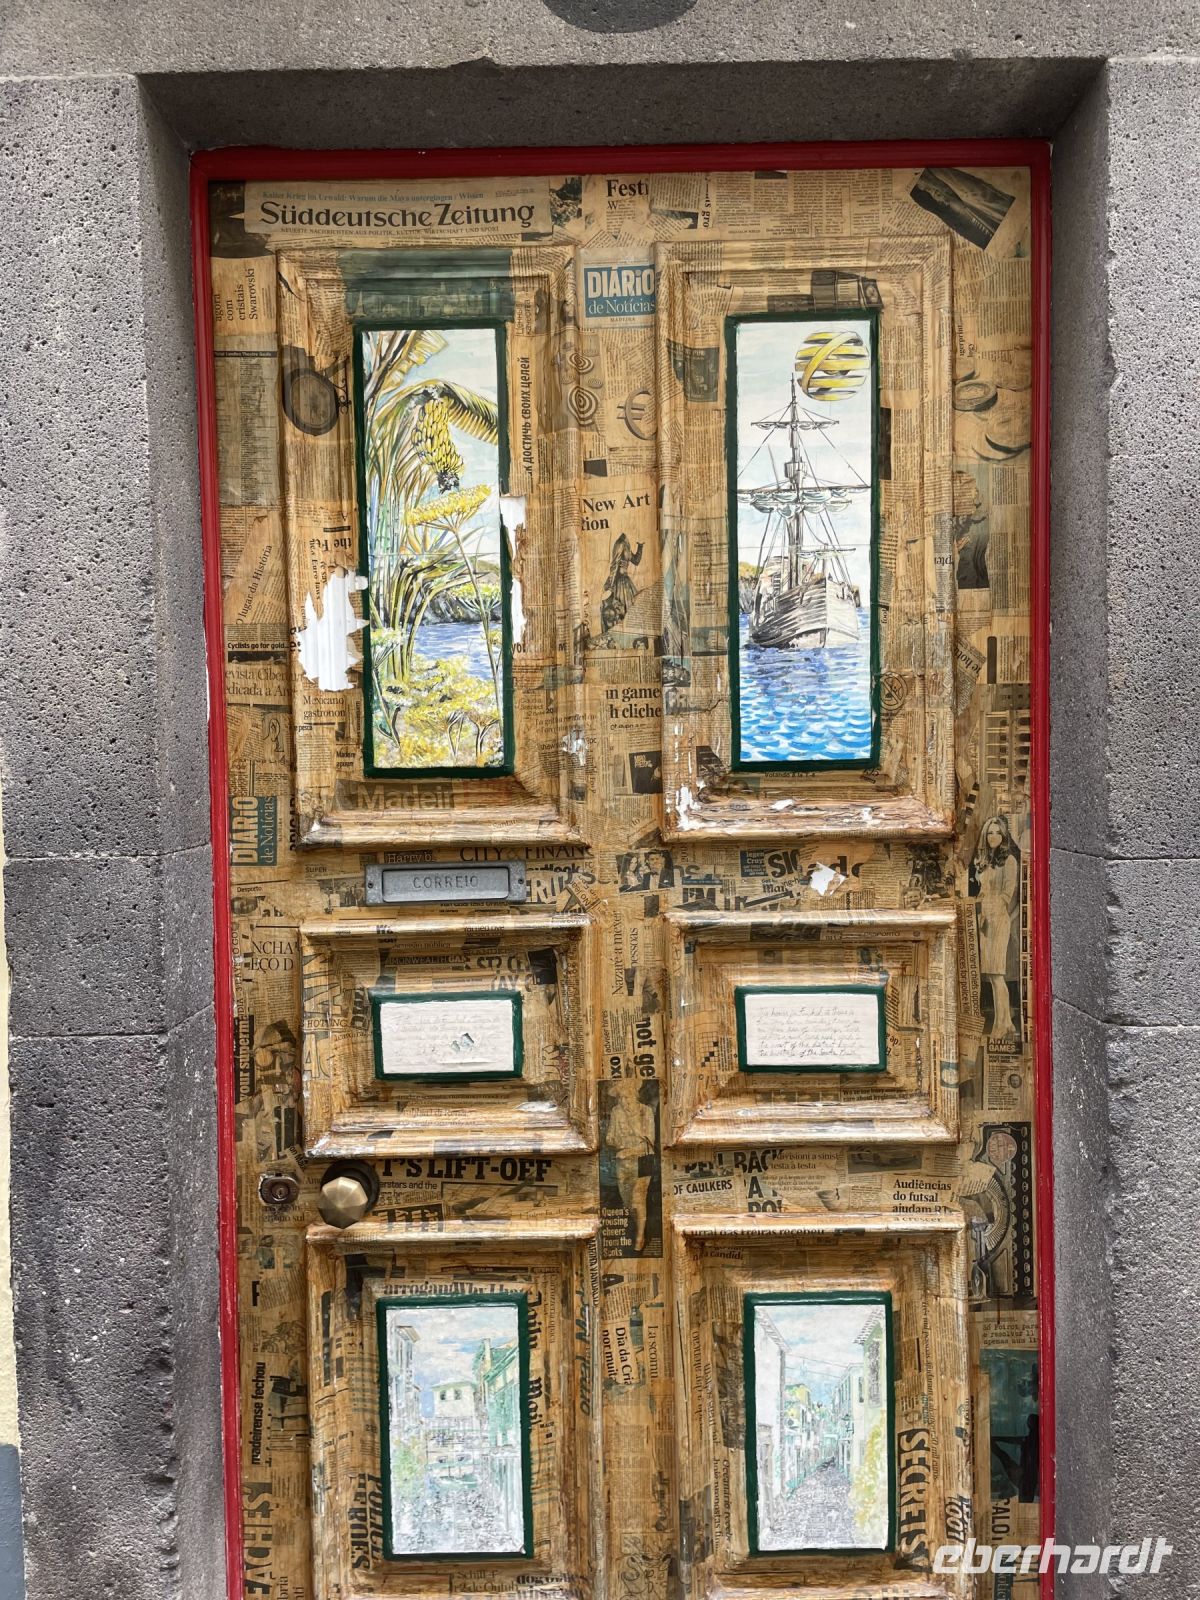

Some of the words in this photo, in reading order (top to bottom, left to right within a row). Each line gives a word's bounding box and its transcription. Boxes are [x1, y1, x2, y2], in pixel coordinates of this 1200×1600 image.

[260, 200, 432, 228] Süddeutsche
[434, 203, 535, 229] Zeitung
[234, 284, 246, 321] cristais
[245, 268, 258, 320] Swarovski
[213, 294, 224, 322] agora
[225, 300, 234, 321] com
[588, 300, 604, 315] de
[605, 299, 655, 314] Notícias
[517, 357, 533, 388] целей
[520, 390, 531, 420] своих
[520, 422, 534, 464] достичь
[582, 498, 616, 514] New
[622, 493, 651, 509] Art
[252, 545, 273, 581] História
[248, 582, 259, 595] da
[239, 591, 254, 618] lugar
[303, 694, 344, 705] Mexicano
[260, 797, 274, 847] Notícias
[260, 848, 274, 863] de
[460, 847, 502, 862] CITY
[412, 874, 479, 890] CORREIO
[965, 903, 974, 919] Fury
[967, 919, 974, 927] as
[967, 928, 975, 943] two
[968, 943, 977, 969] ex-Yard
[610, 956, 624, 996] Nazaré
[970, 969, 979, 990] chiefs
[959, 981, 969, 1002] police
[600, 1010, 609, 1028] hires
[603, 1028, 612, 1053] adviser
[635, 1016, 657, 1048] not
[238, 1072, 251, 1103] your
[426, 1157, 552, 1182] LIFT-OFF
[771, 1162, 790, 1170] testa
[797, 1162, 816, 1170] testa
[408, 1181, 424, 1190] and
[424, 1181, 438, 1190] the
[686, 1179, 733, 1194] CAULKERS
[893, 1178, 951, 1191] Audiências
[892, 1191, 906, 1202] do
[908, 1191, 939, 1202] futsal
[602, 1207, 629, 1217] Queen's
[602, 1216, 628, 1228] rousing
[602, 1227, 626, 1236] cheers
[603, 1237, 620, 1247] from
[620, 1236, 632, 1246] the
[603, 1247, 622, 1257] Scots
[615, 1327, 628, 1347] Dia
[648, 1325, 659, 1340] La
[619, 1348, 631, 1363] da
[251, 1361, 266, 1400] fechou
[249, 1401, 265, 1466] madeirense
[898, 1430, 930, 1555] SECRETS
